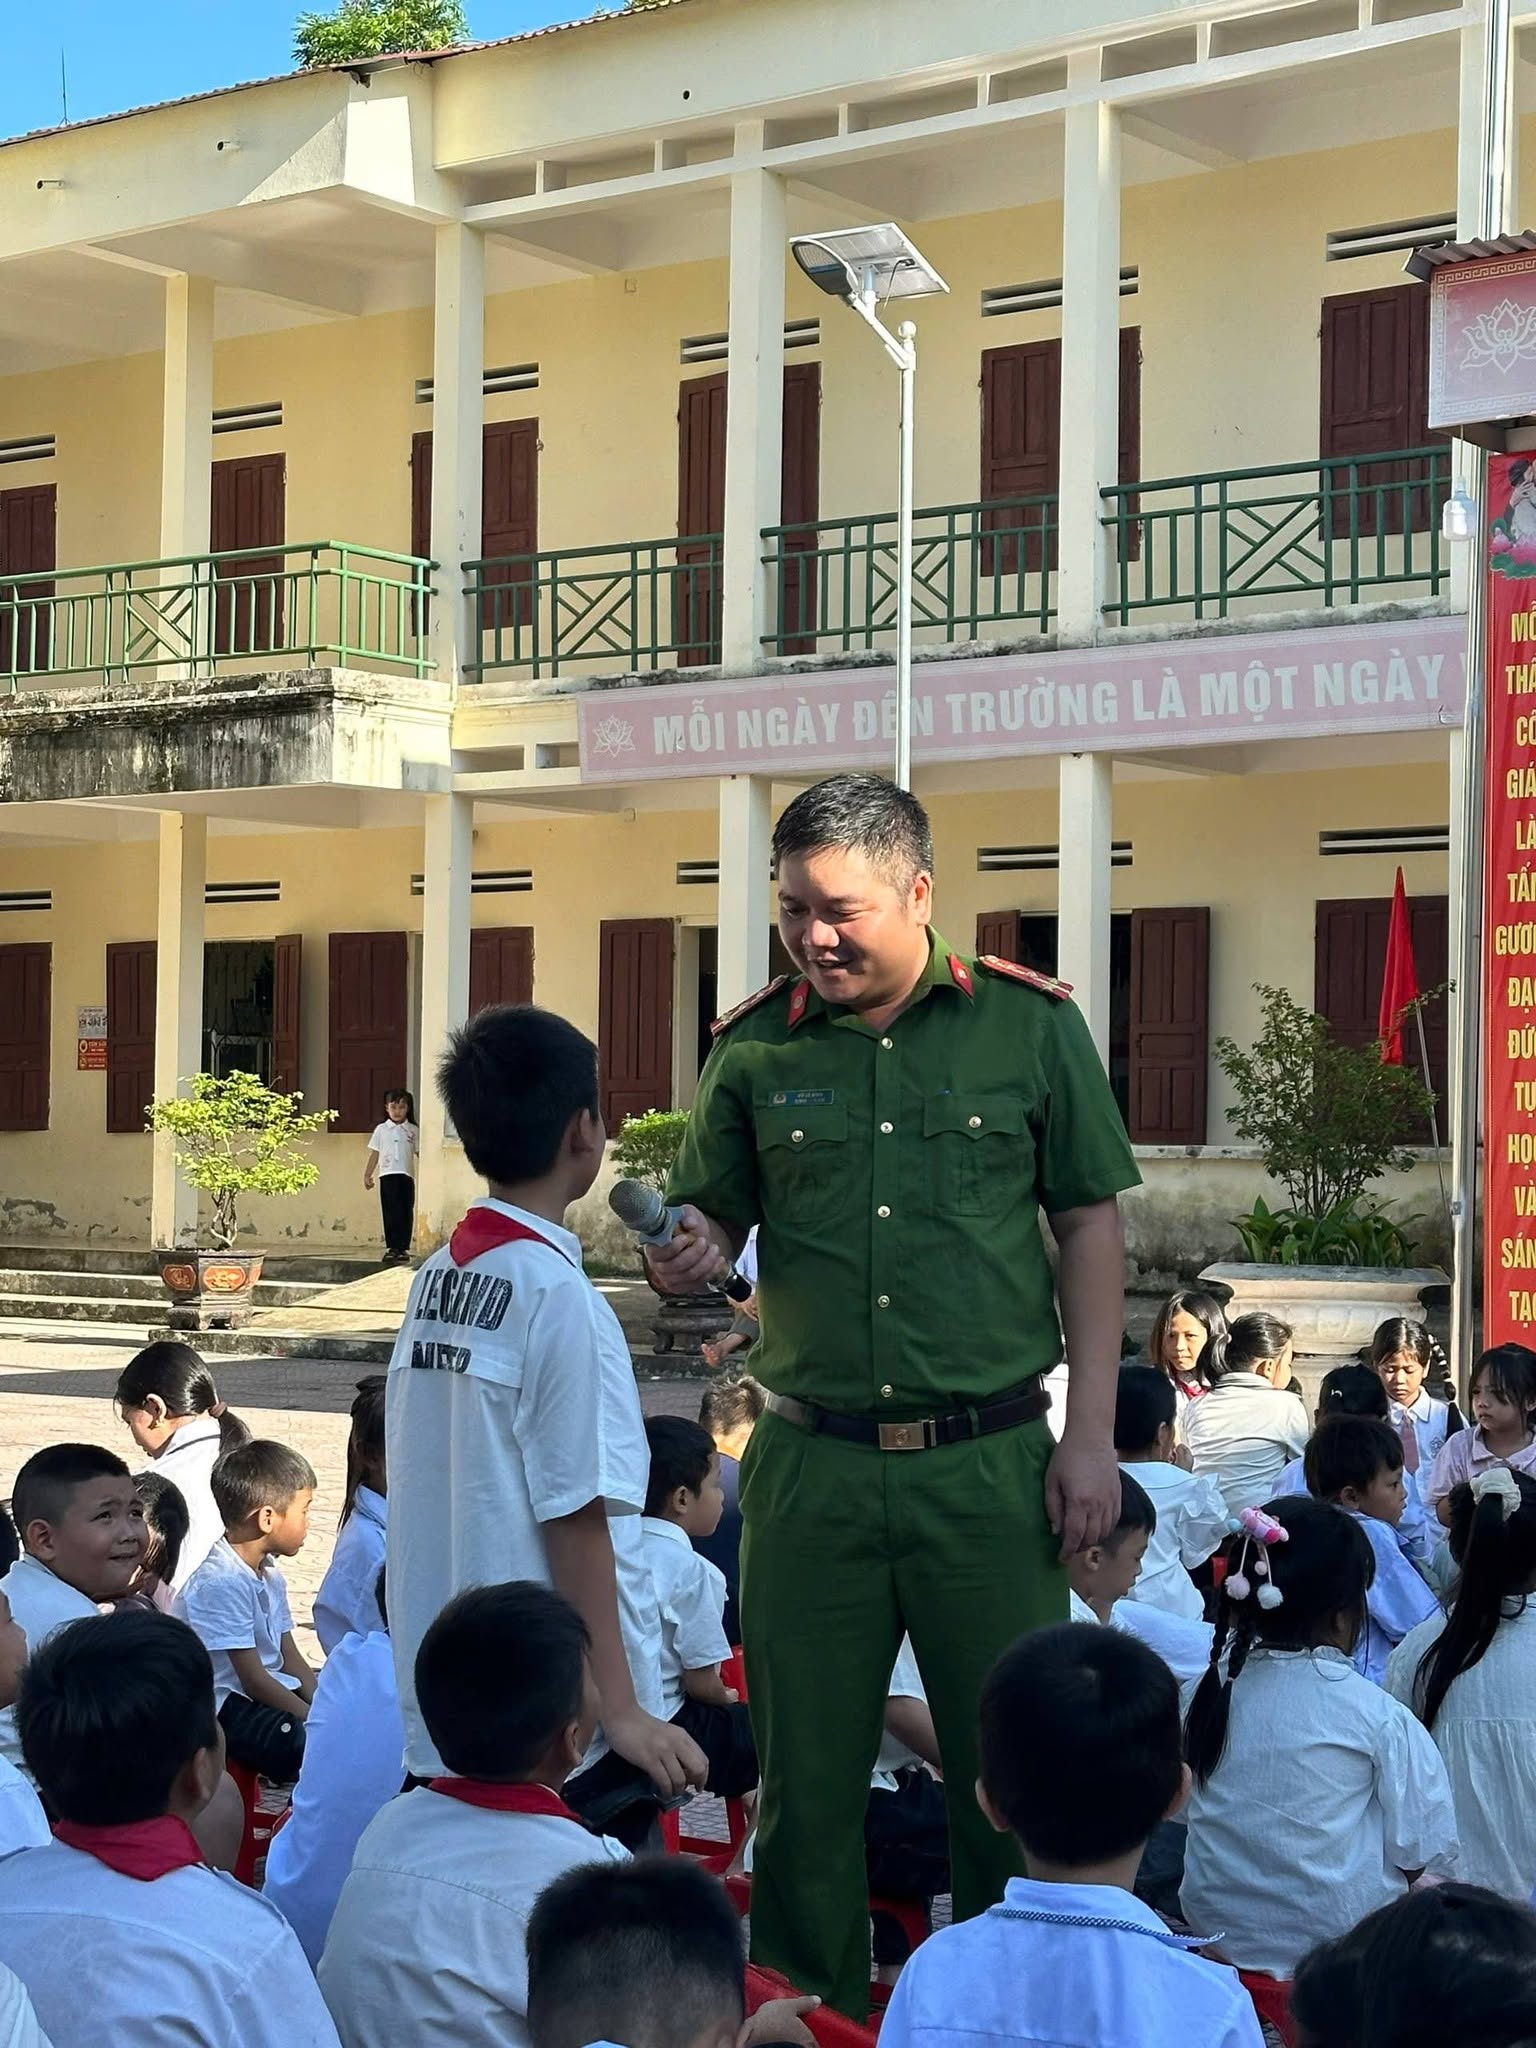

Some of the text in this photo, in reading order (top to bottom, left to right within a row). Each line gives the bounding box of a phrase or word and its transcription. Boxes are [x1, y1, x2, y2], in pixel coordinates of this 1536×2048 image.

[653, 698, 725, 754] MỖI
[737, 697, 840, 749] NGÀY
[946, 676, 1118, 734] TRƯỜNG
[1132, 667, 1186, 721] LÀ
[1200, 659, 1298, 722] MỘT
[1313, 648, 1444, 708] NGÀY
[1495, 922, 1536, 955] GƯƠ
[1508, 976, 1536, 1014] ĐẠ
[1508, 1023, 1536, 1059] ĐỨ
[1507, 1133, 1536, 1170] HỌ
[413, 1268, 514, 1332] LEGEND
